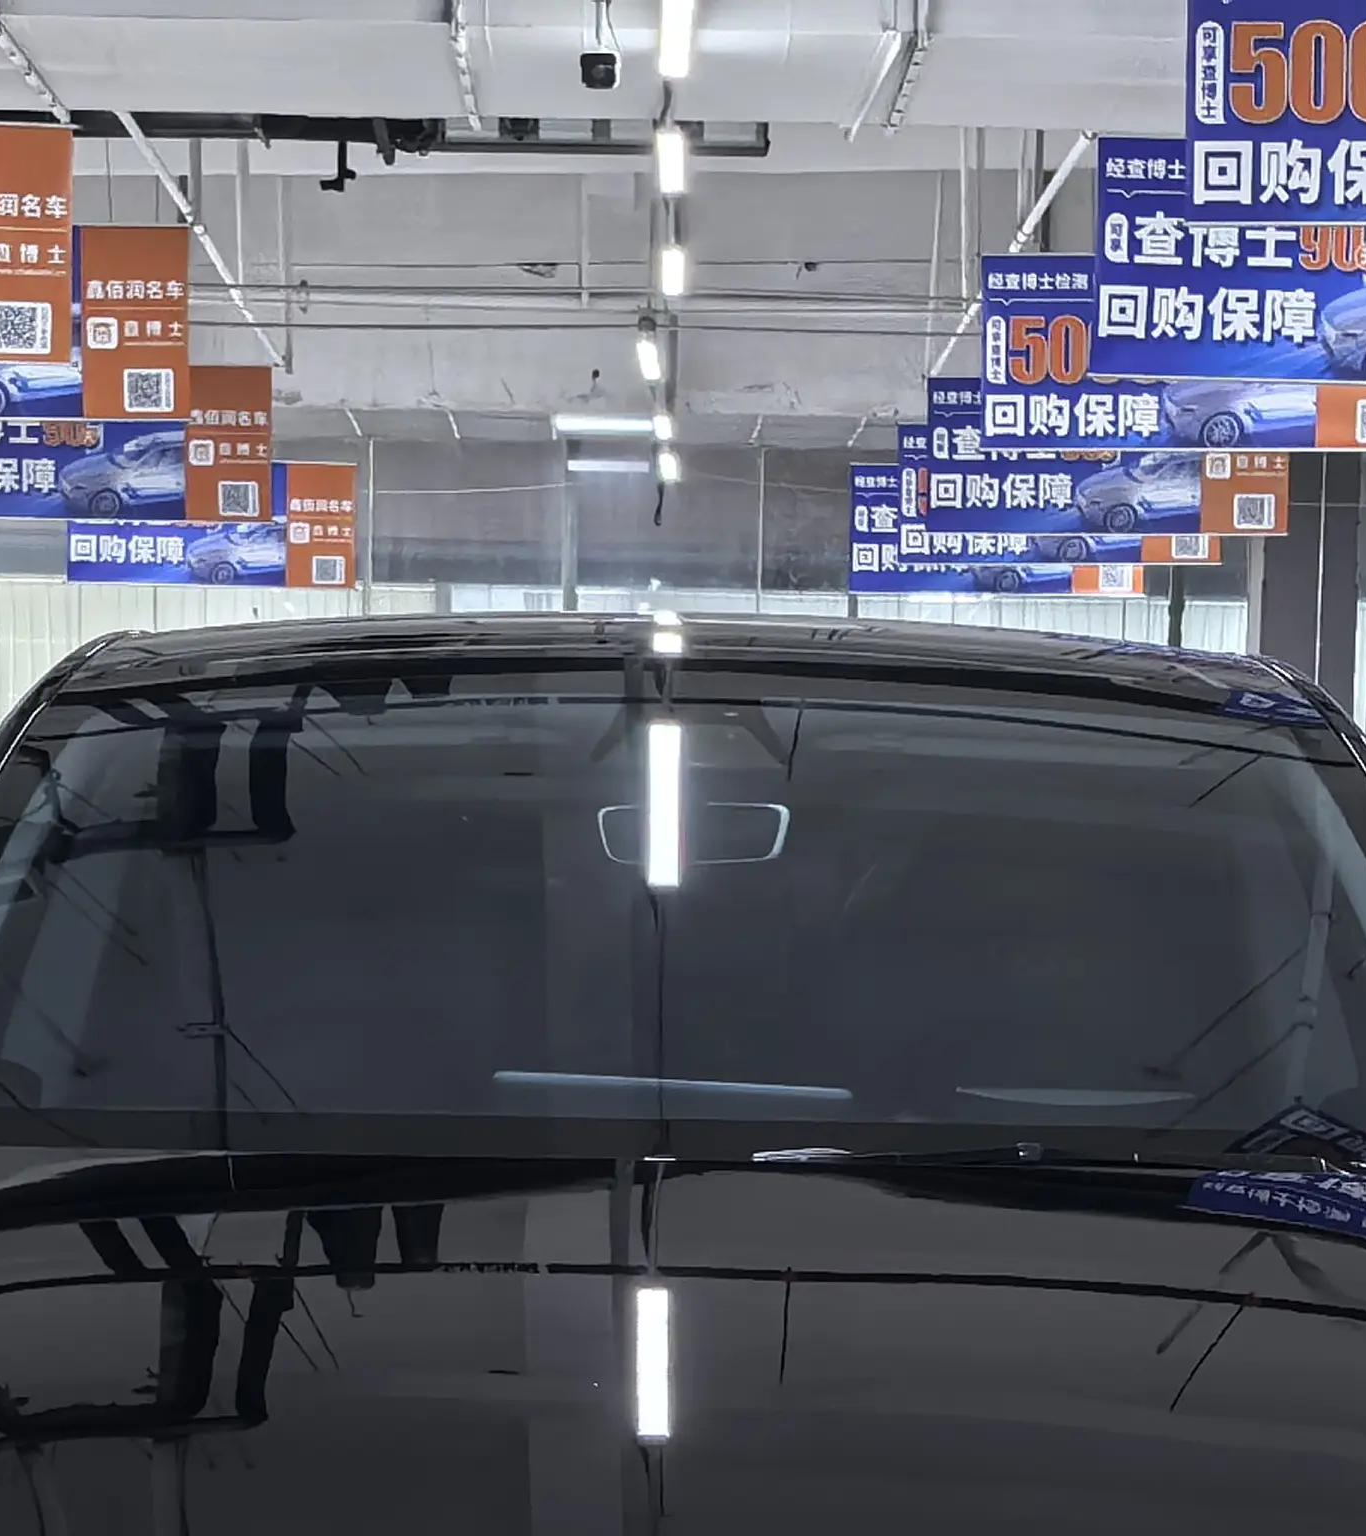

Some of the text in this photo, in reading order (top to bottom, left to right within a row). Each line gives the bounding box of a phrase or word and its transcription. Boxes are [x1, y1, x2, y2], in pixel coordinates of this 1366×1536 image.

[1105, 156, 1186, 181] 经查博士
[86, 280, 184, 301] 鑫佰润名车
[1097, 284, 1318, 343] 回购保障
[985, 392, 1160, 439] 回购保障
[930, 473, 1073, 510] 回购保障
[69, 532, 185, 566] 回购保障
